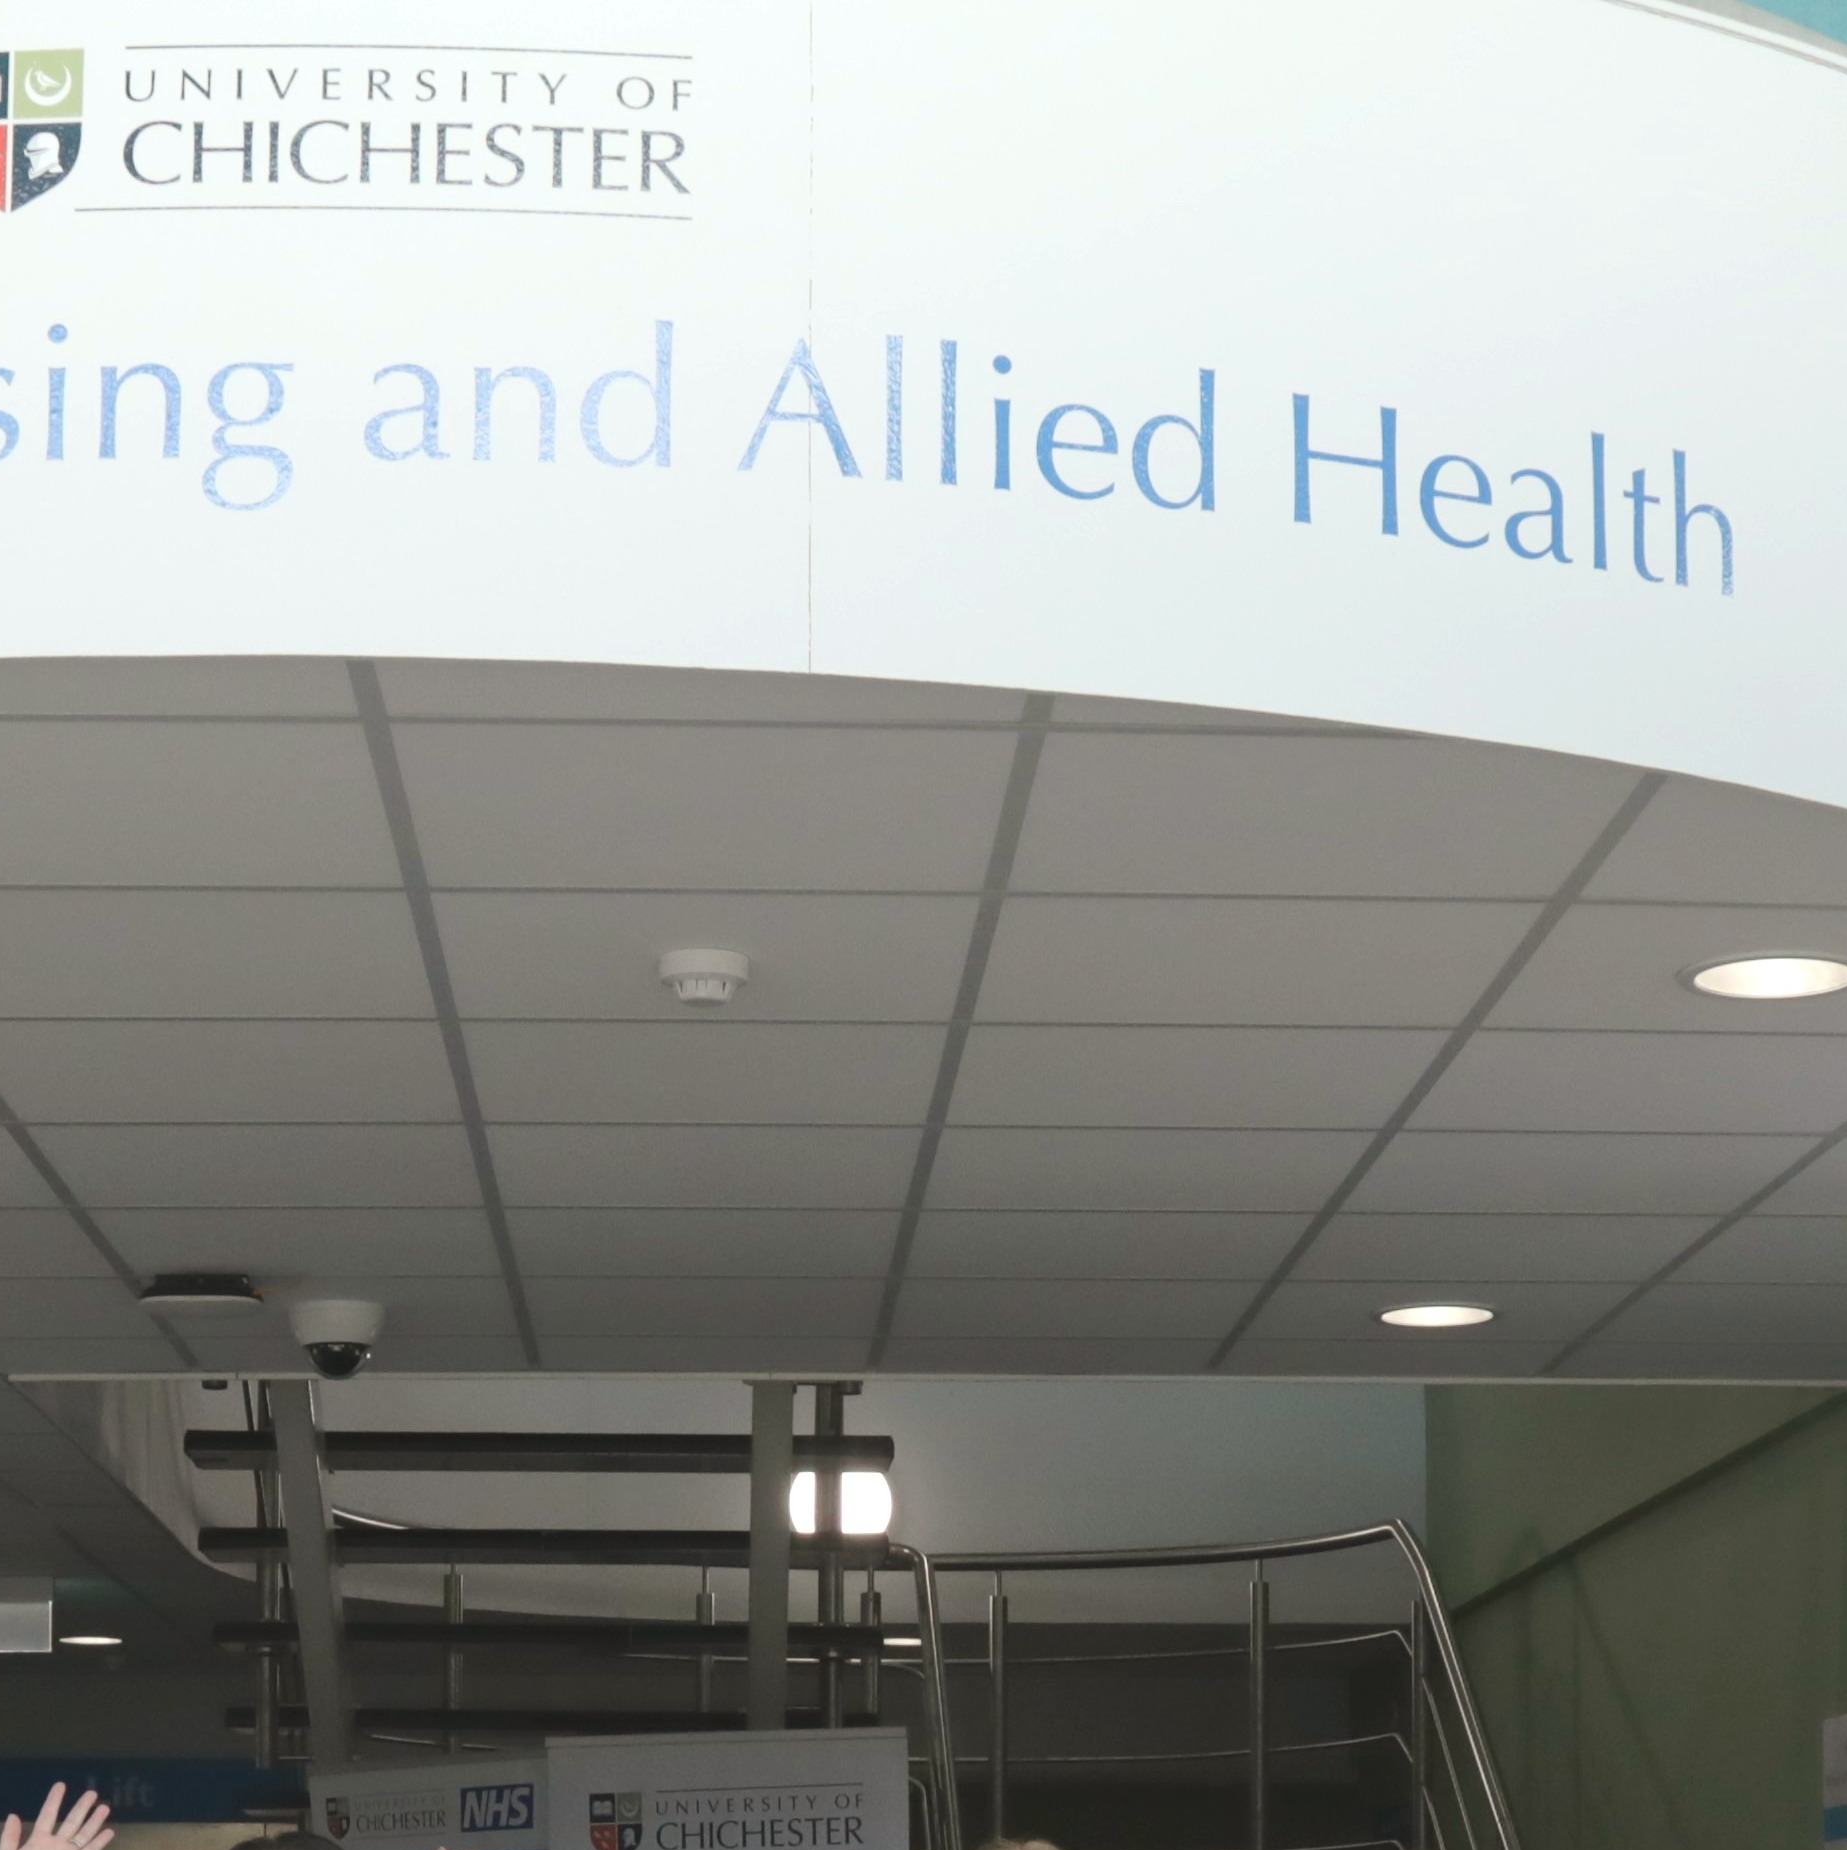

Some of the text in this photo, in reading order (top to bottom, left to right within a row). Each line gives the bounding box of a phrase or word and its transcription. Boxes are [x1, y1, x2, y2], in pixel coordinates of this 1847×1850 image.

[123, 68, 693, 112] UNIVERSITY OF
[122, 118, 693, 196] CHICHESTER
[361, 319, 675, 470] and
[736, 333, 1217, 513] Allied
[1292, 391, 1736, 597] Health
[356, 1809, 447, 1834] CHICHESTER
[462, 1786, 532, 1829] NHS
[655, 1791, 864, 1816] UNIVERSITY OF
